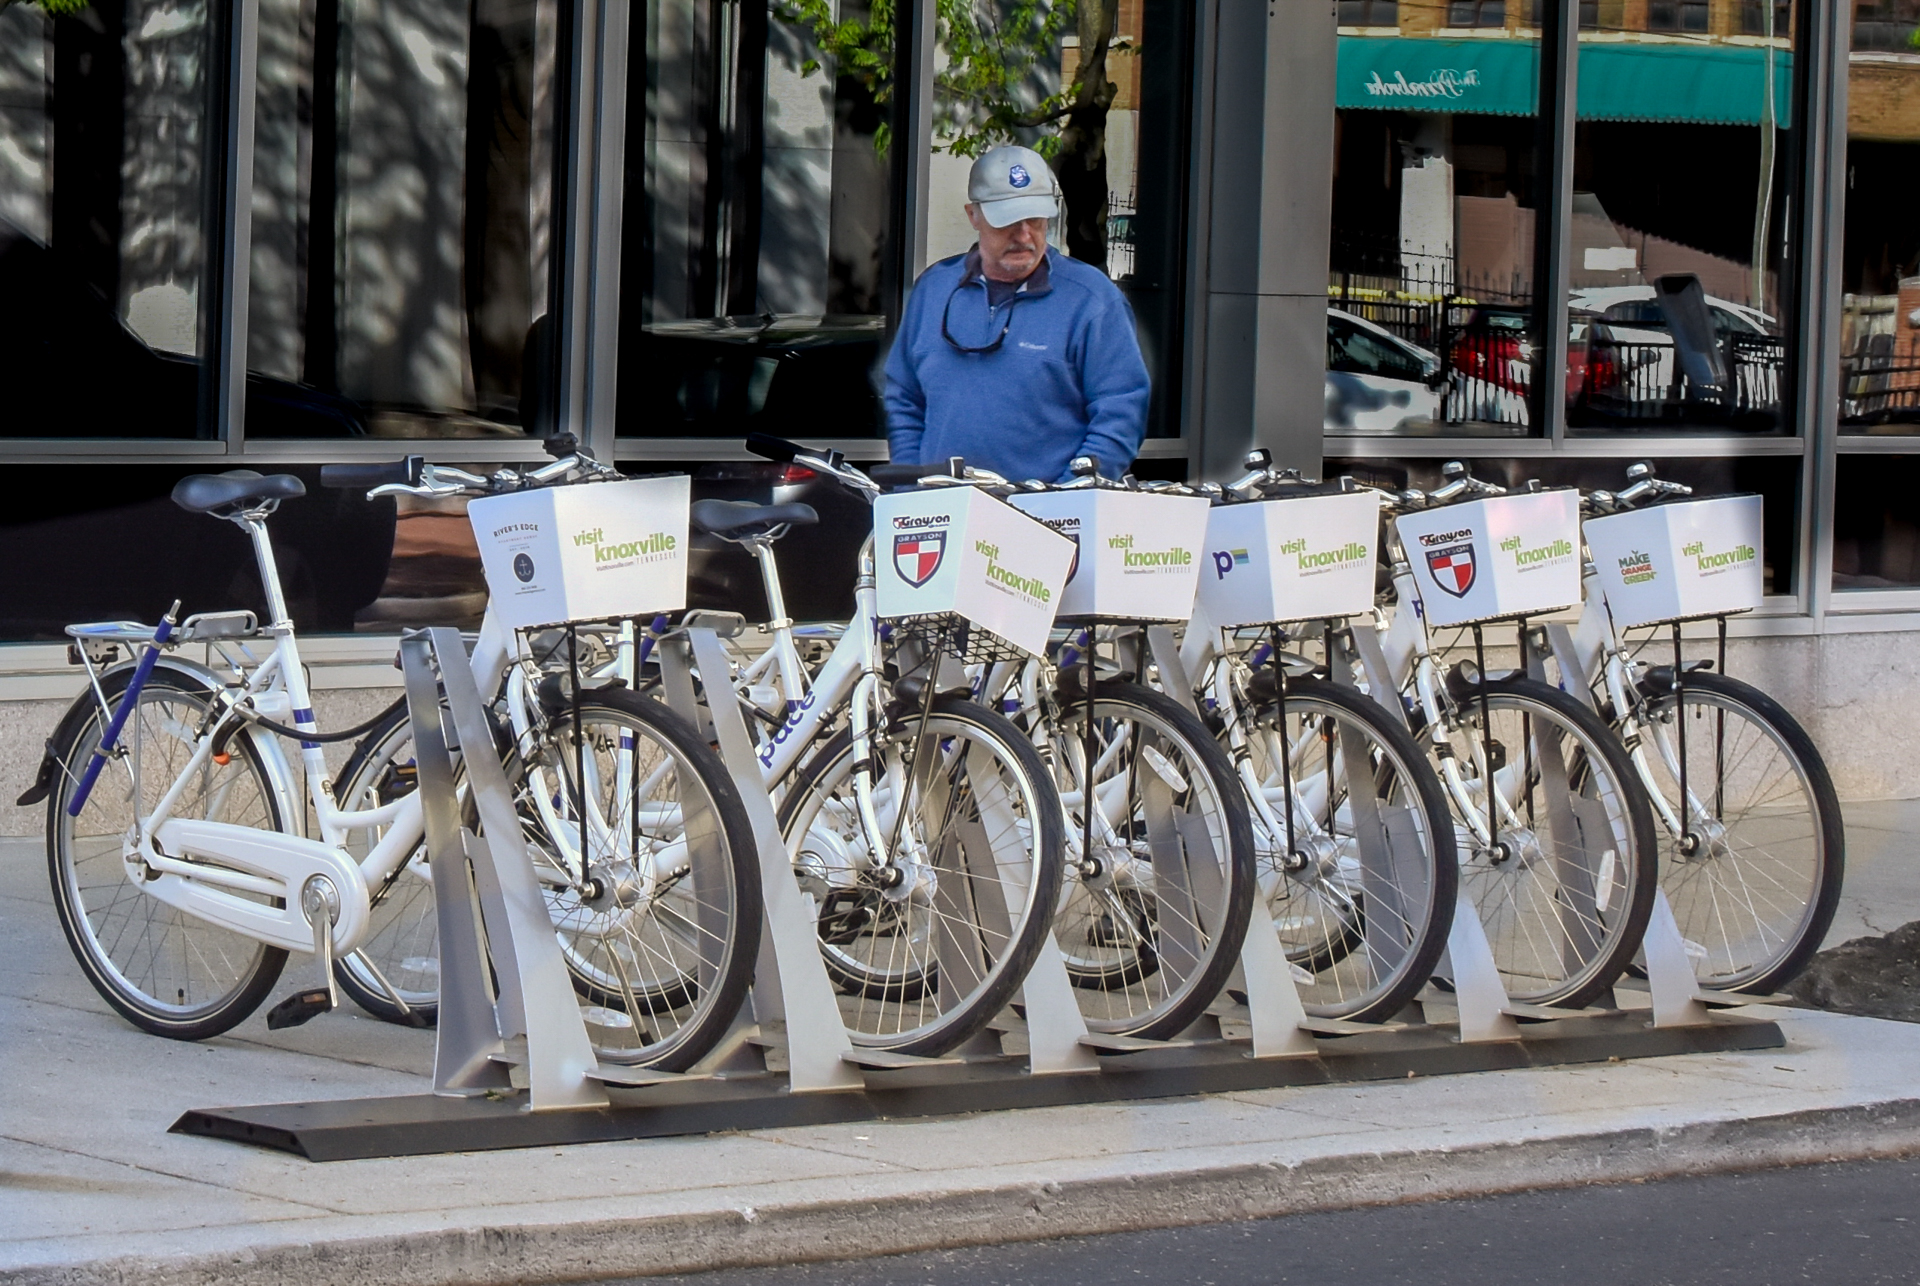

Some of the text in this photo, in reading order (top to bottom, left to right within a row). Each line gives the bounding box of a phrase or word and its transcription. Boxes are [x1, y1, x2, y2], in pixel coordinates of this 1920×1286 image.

[493, 523, 538, 537] RIVER'S EDGE
[902, 515, 950, 529] Grayson
[573, 528, 603, 546] visit
[897, 533, 942, 543] GRAYSON
[1108, 534, 1134, 549] visit
[1427, 528, 1472, 546] Grayson
[1500, 536, 1522, 552] visit
[594, 532, 676, 563] knoxville
[975, 539, 999, 560] visit
[1280, 538, 1306, 555] visit
[1298, 542, 1366, 569] knoxville
[1429, 545, 1470, 558] GRAYSON
[1515, 539, 1572, 565] knoxville
[1682, 541, 1704, 557] visit
[1124, 547, 1192, 566] knoxville
[1618, 550, 1650, 568] MAKE
[1697, 544, 1755, 570] knoxville
[1621, 564, 1652, 575] ORANGE
[1623, 571, 1655, 585] GREEN
[986, 558, 1050, 603] knoxville
[759, 691, 816, 769] pace
